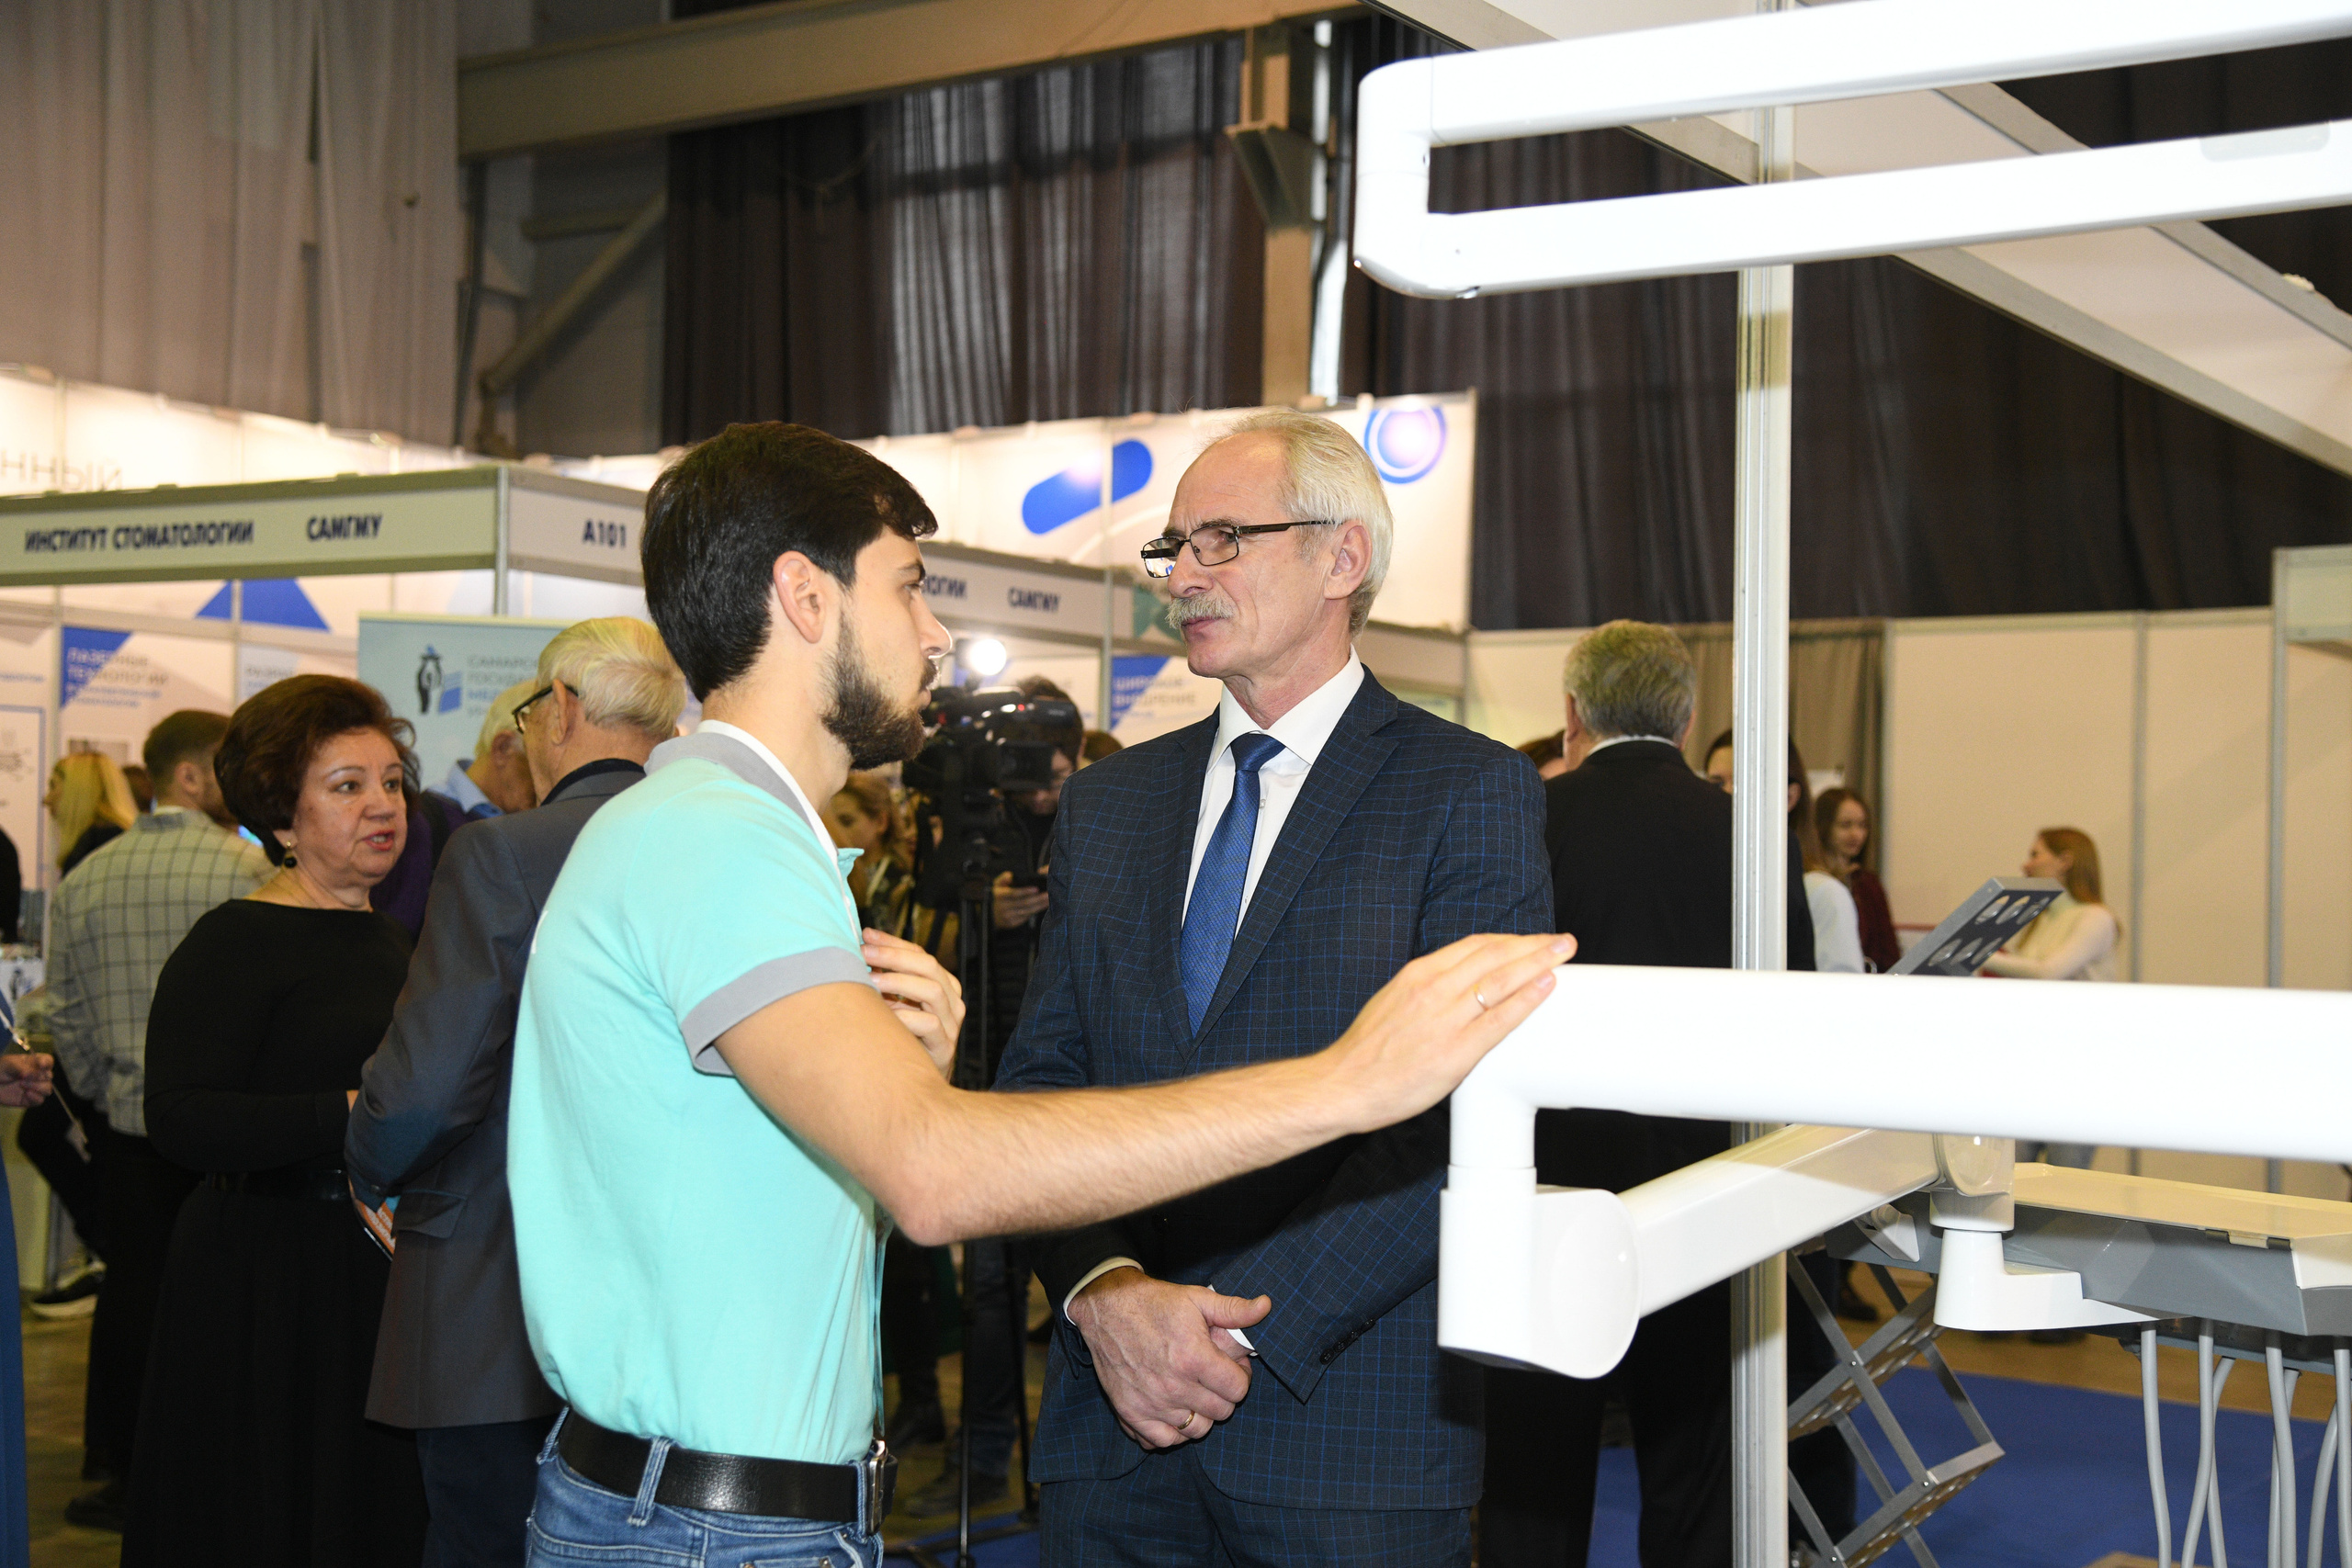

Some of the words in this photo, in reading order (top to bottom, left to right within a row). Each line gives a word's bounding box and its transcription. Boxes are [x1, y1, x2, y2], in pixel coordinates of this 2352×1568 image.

[25, 525, 107, 553] ИНСТИТУТ
[112, 519, 254, 549] СТОМАТОЛОГИИ
[307, 513, 383, 542] САМГМУ
[1008, 585, 1061, 613] САМГМУ
